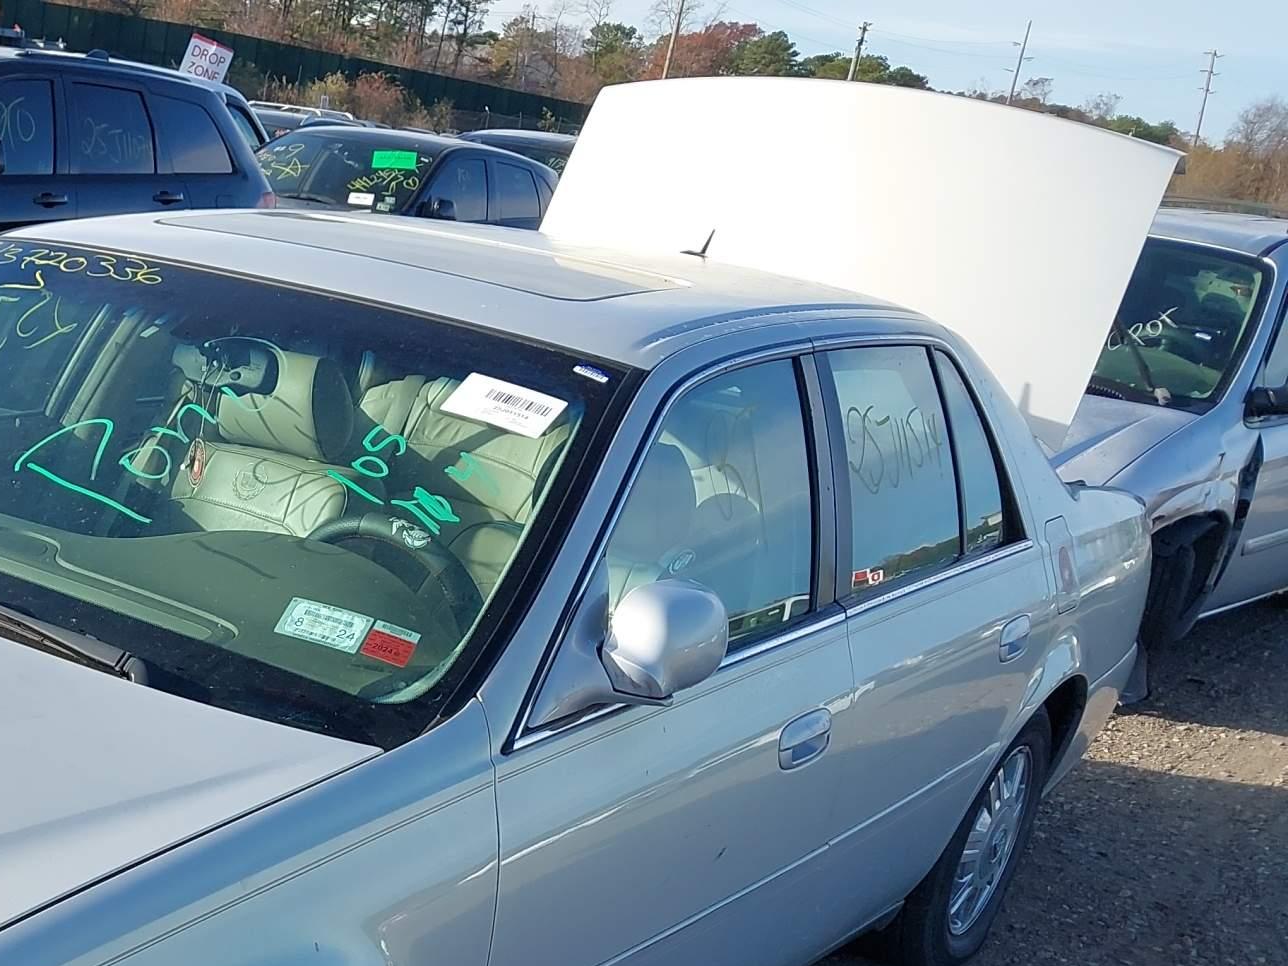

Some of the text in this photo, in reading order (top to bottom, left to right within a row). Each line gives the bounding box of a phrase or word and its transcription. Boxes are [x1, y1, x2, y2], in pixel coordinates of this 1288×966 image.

[191, 44, 226, 67] DROP
[187, 61, 221, 81] ZONE
[335, 629, 356, 642] 24
